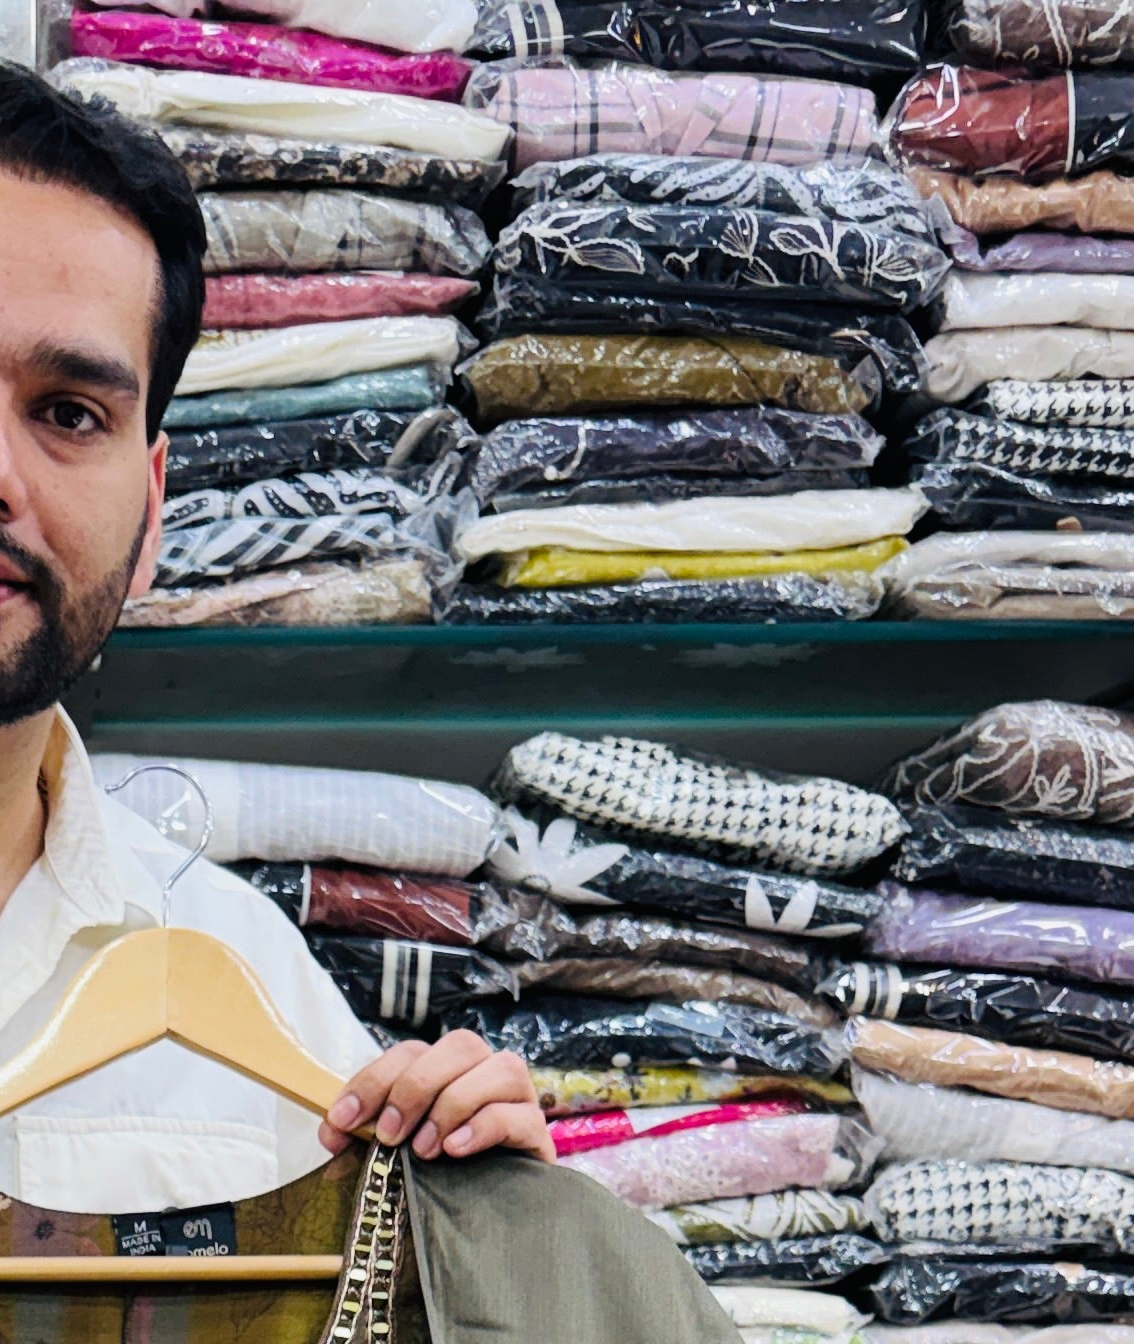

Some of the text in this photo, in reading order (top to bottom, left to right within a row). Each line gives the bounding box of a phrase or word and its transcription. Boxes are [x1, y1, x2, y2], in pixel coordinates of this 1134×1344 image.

[134, 1220, 146, 1233] M
[122, 1234, 162, 1249] MADE IN
[130, 1244, 156, 1256] INDIA
